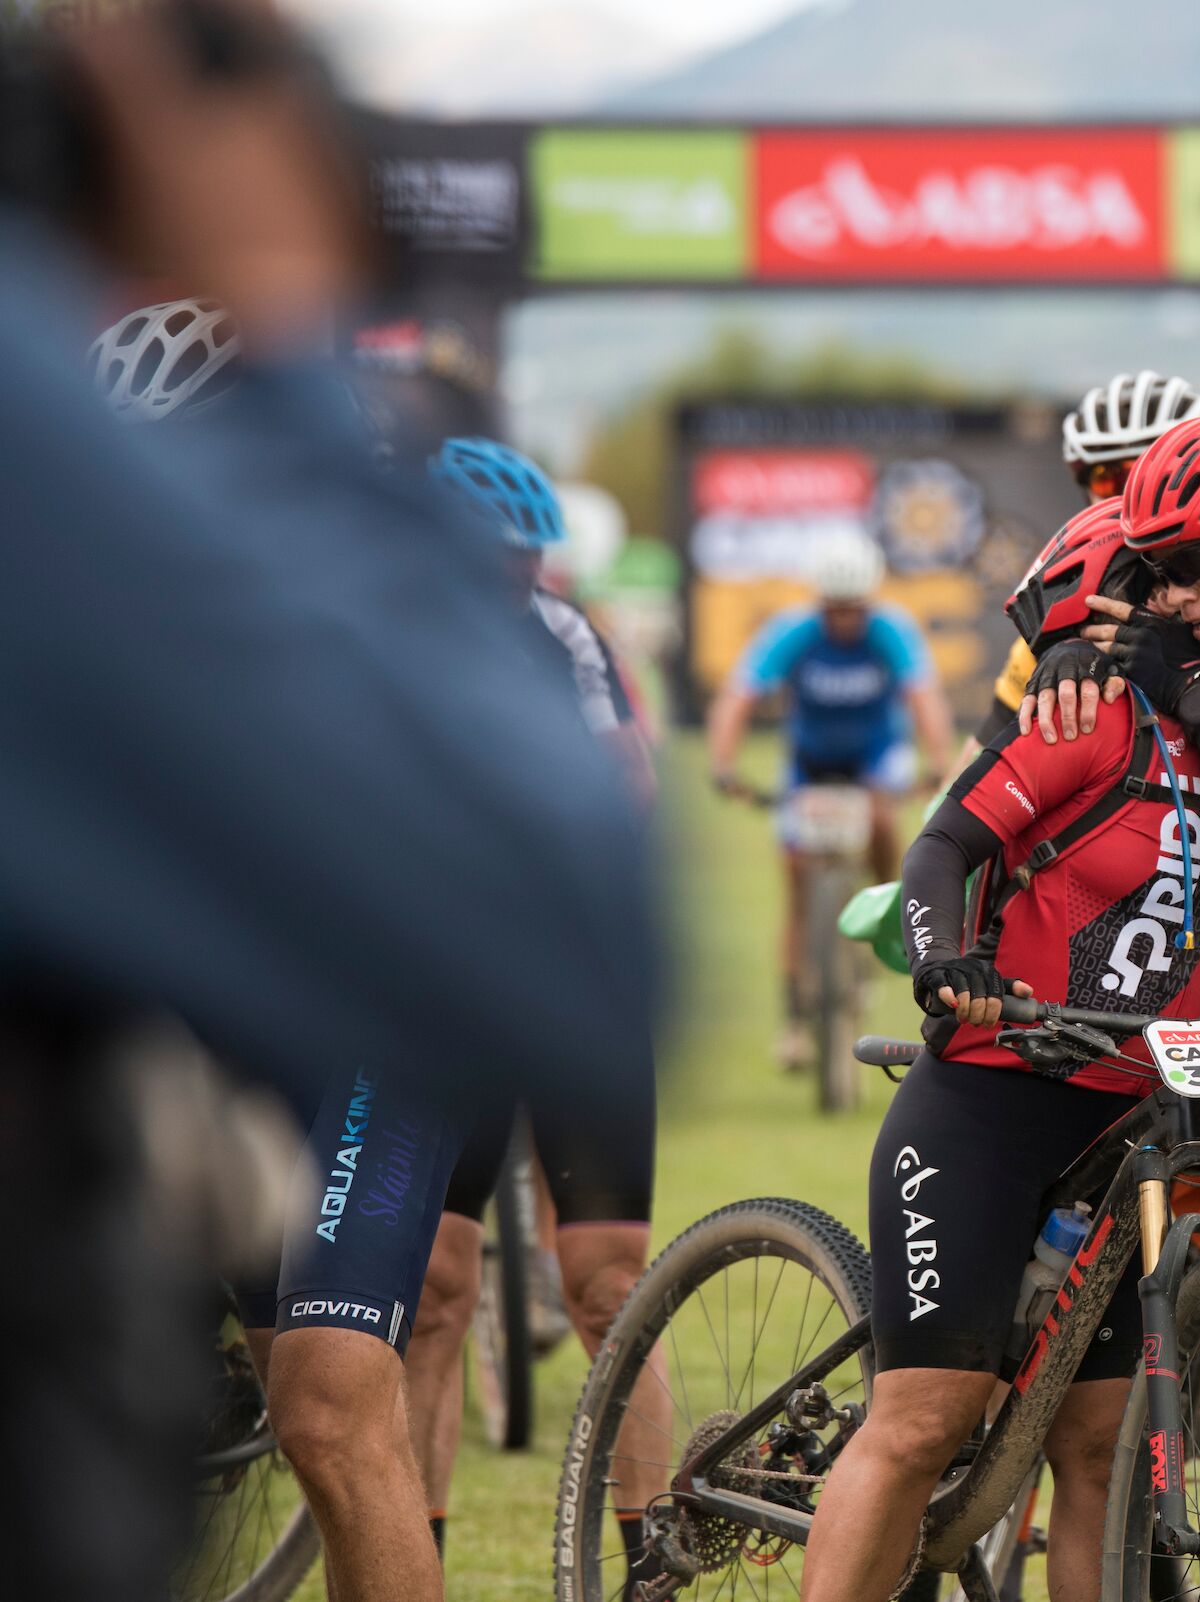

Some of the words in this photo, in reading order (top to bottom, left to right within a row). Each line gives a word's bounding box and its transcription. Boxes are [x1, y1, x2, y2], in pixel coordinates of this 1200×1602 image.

[903, 1209, 940, 1321] ABSA
[291, 1300, 382, 1324] CIOVITA
[561, 1414, 593, 1568] SAGUARO
[1150, 1432, 1168, 1494] FOX
